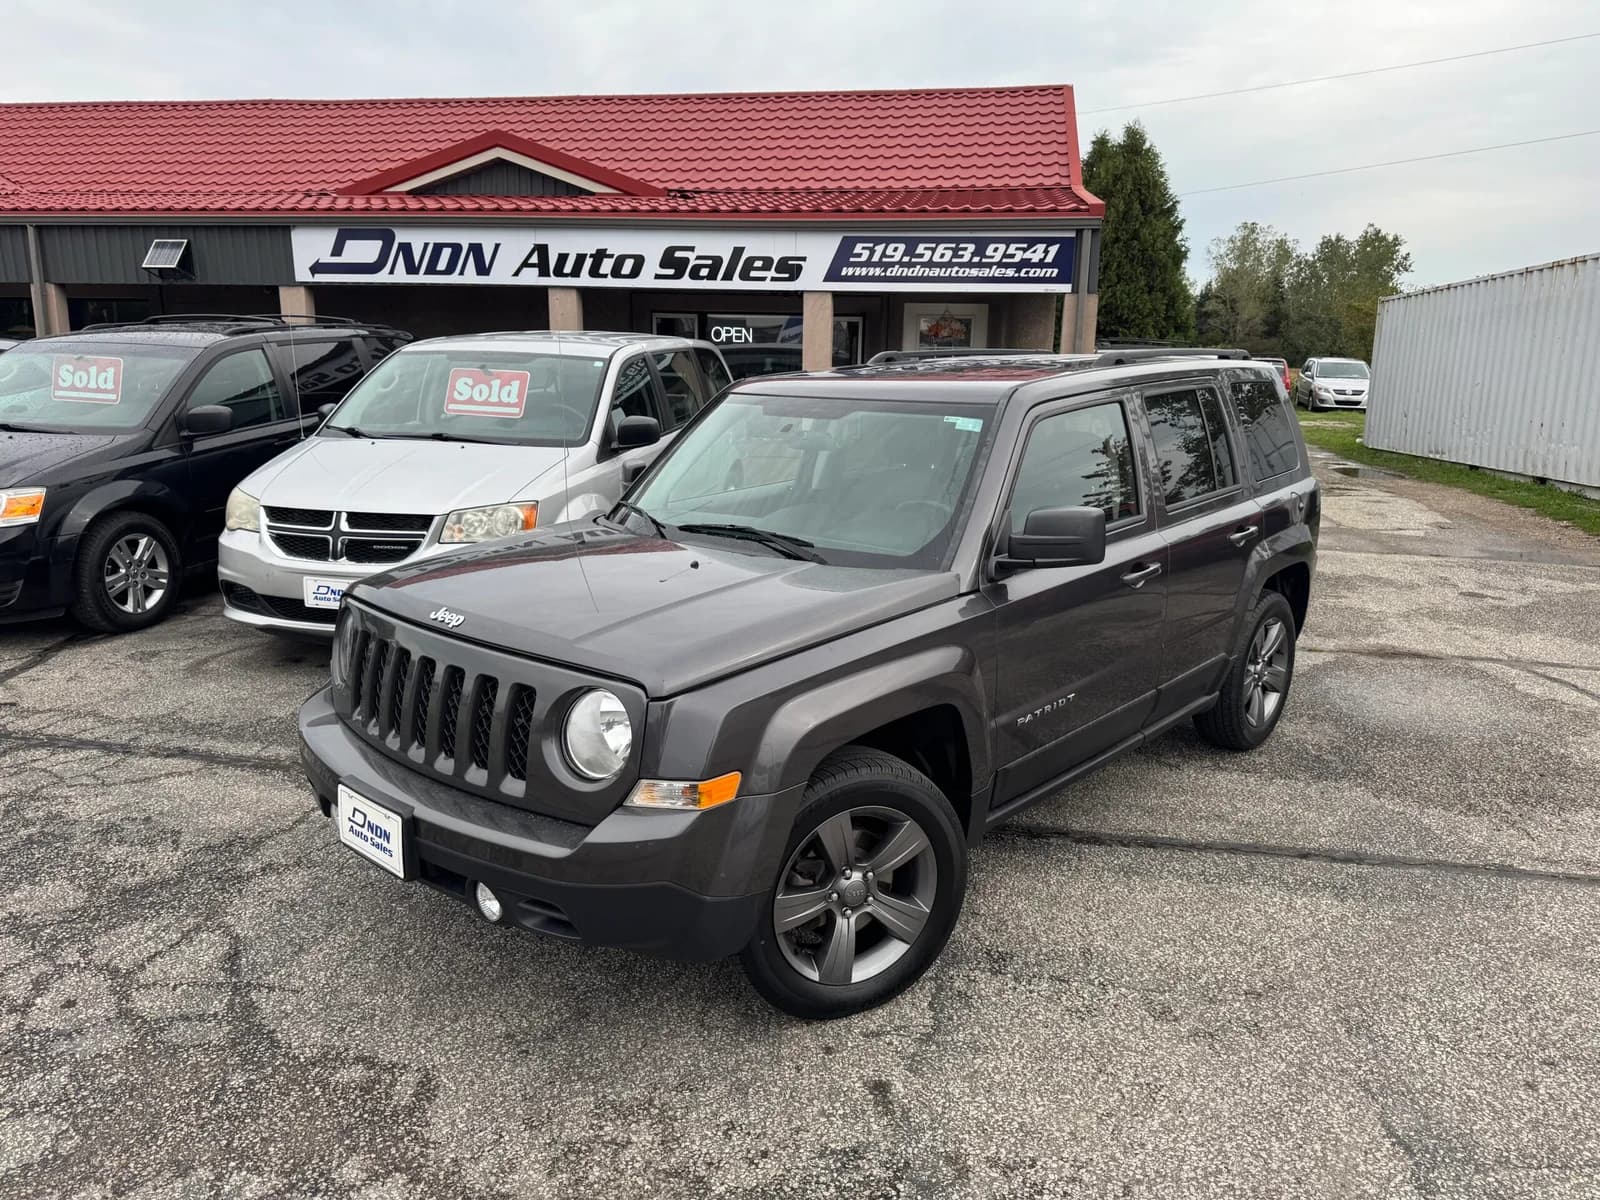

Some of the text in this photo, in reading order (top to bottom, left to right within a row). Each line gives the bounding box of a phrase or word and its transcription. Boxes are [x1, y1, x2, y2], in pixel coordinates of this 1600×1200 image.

[308, 228, 807, 282] DNDN Auto Sales
[850, 243, 1060, 263] 519.563.9541
[841, 264, 1058, 278] www.dndnautosales.com
[711, 326, 753, 343] OPEN
[58, 364, 114, 389] Sold
[453, 377, 520, 403] Sold
[429, 607, 465, 628] Jeep
[1017, 693, 1076, 727] PATRIOT
[348, 807, 391, 844] DNDN
[348, 825, 393, 858] Auto Sales
